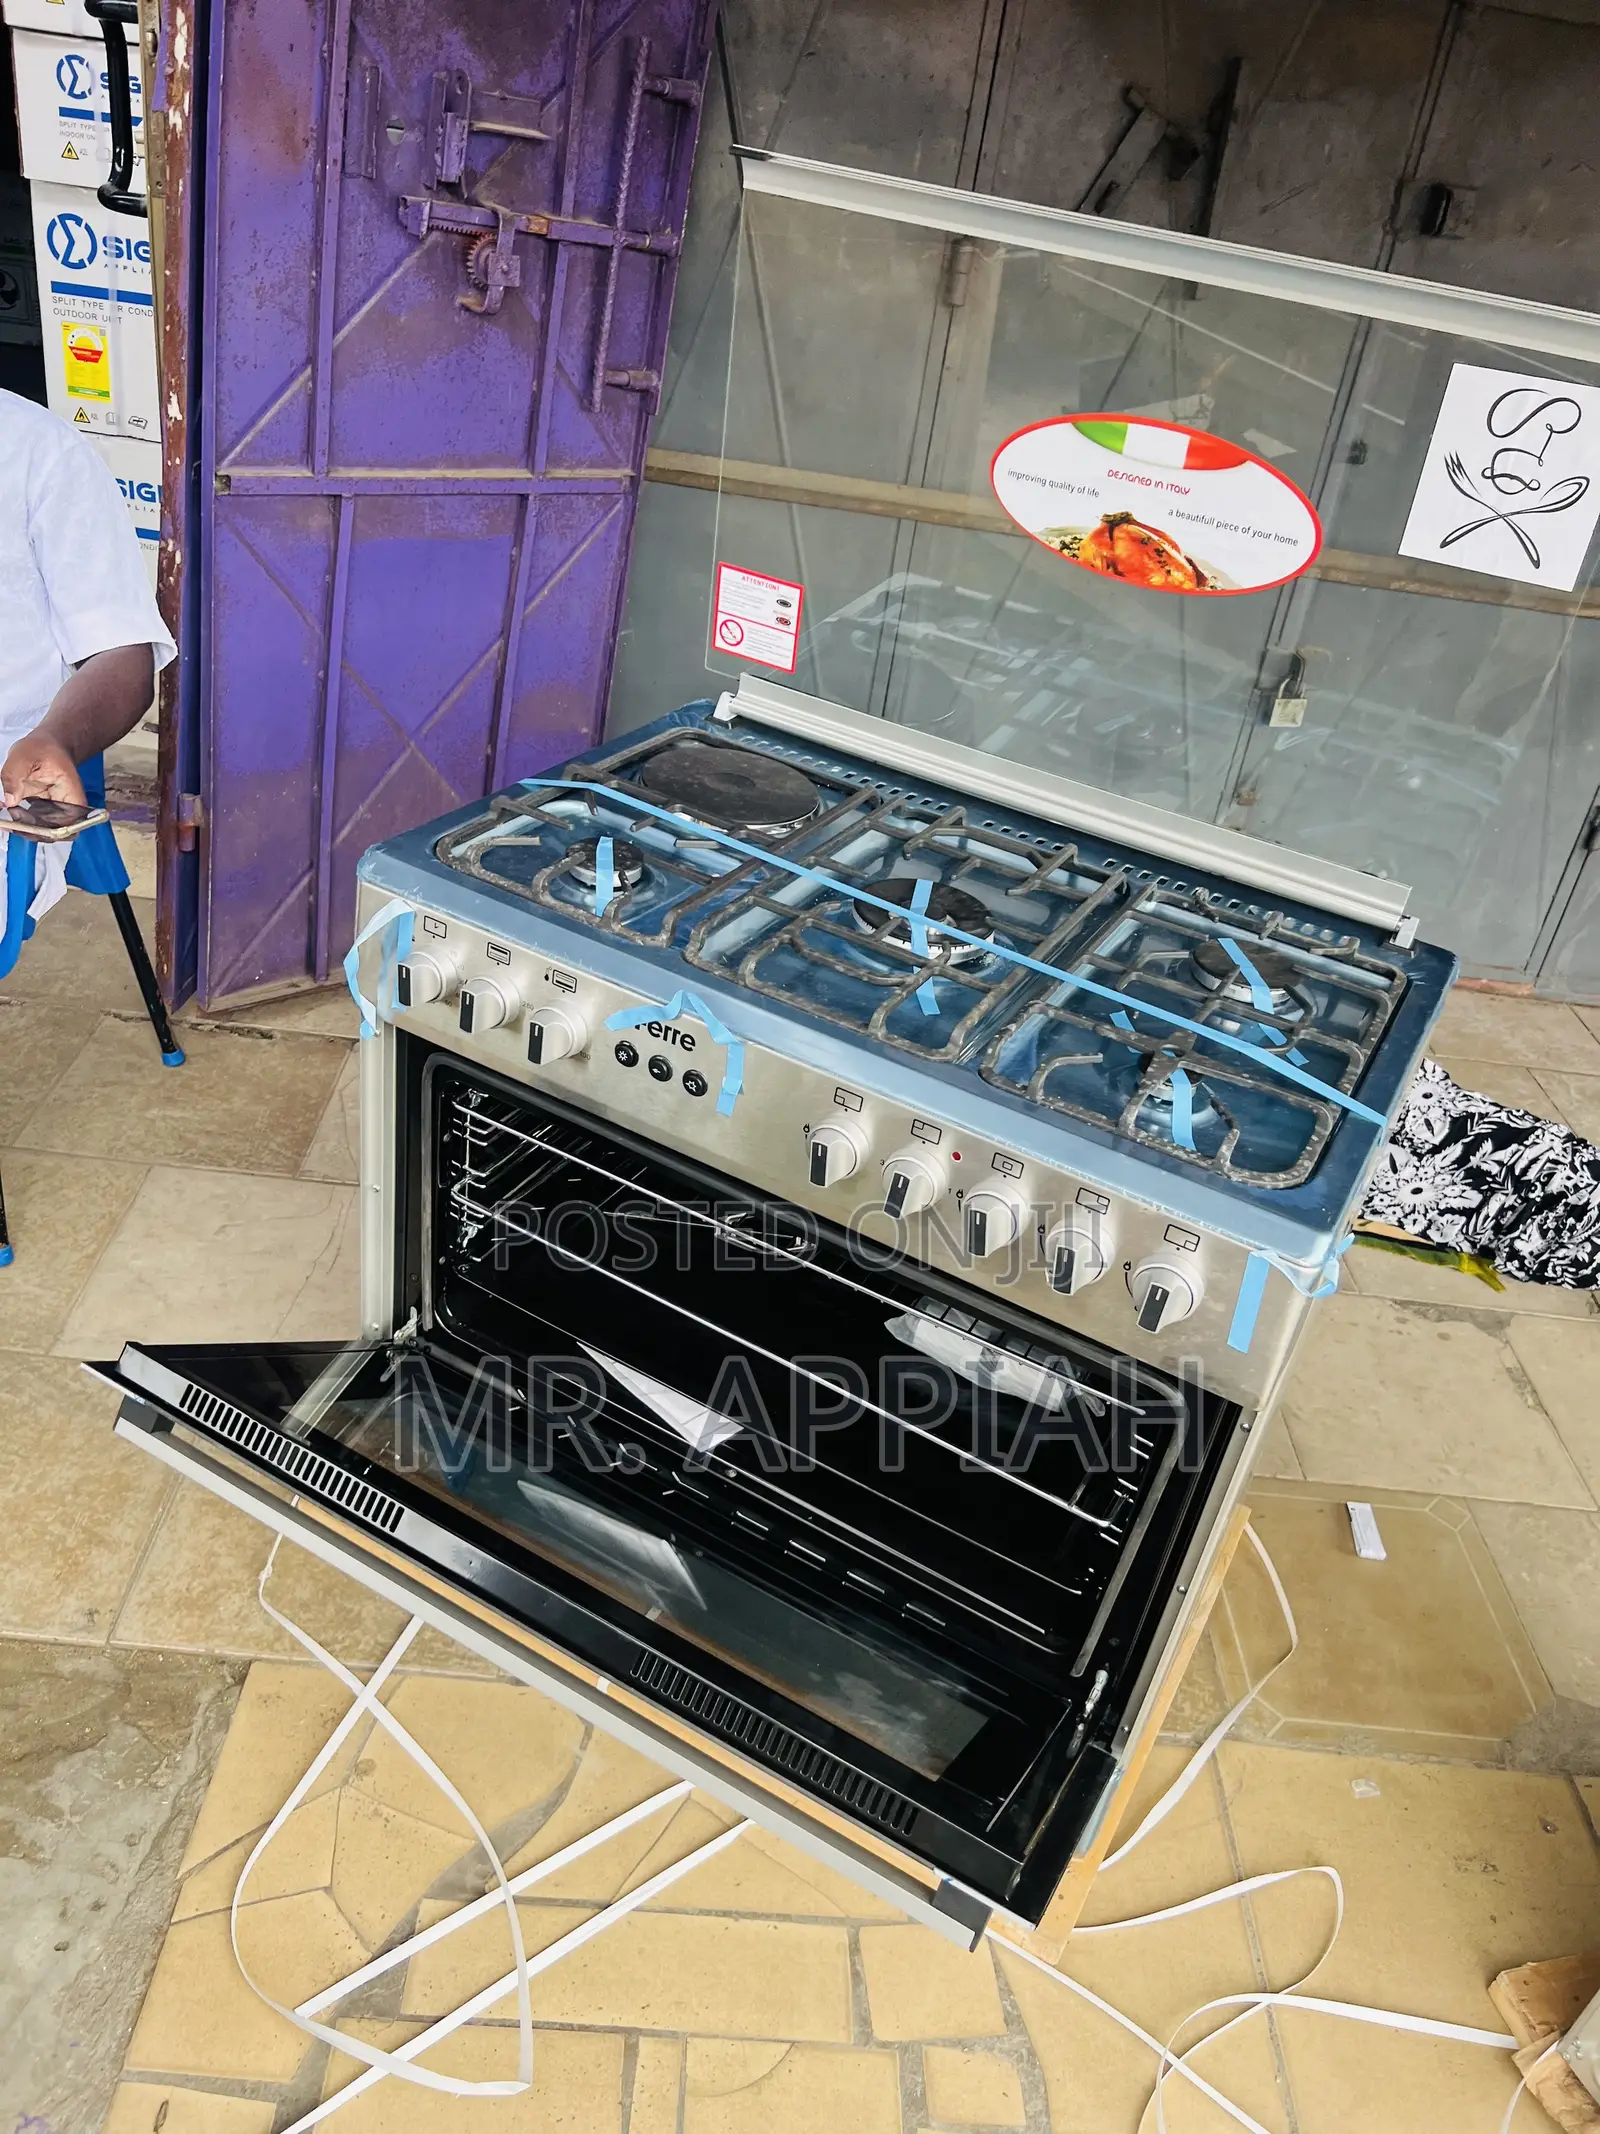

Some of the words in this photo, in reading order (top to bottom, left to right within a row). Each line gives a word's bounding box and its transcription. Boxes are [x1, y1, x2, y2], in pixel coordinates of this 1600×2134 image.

[100, 72, 142, 94] SG
[52, 295, 77, 306] SPLIT
[82, 300, 104, 311] TYPE
[53, 307, 98, 321] OUTDOOR
[1007, 468, 1047, 487] improving
[1049, 479, 1075, 494] quality
[1077, 485, 1086, 495] of
[1087, 487, 1100, 498] life
[1107, 469, 1152, 487] DESIGNED
[1154, 480, 1164, 490] IN
[1166, 482, 1191, 496] ITALY
[1168, 508, 1174, 516] a
[1175, 508, 1215, 526] beautifull
[1216, 519, 1240, 533] piece
[1241, 525, 1251, 535] of
[1252, 529, 1272, 540] your
[1273, 532, 1299, 547] home
[634, 1020, 697, 1052] erre
